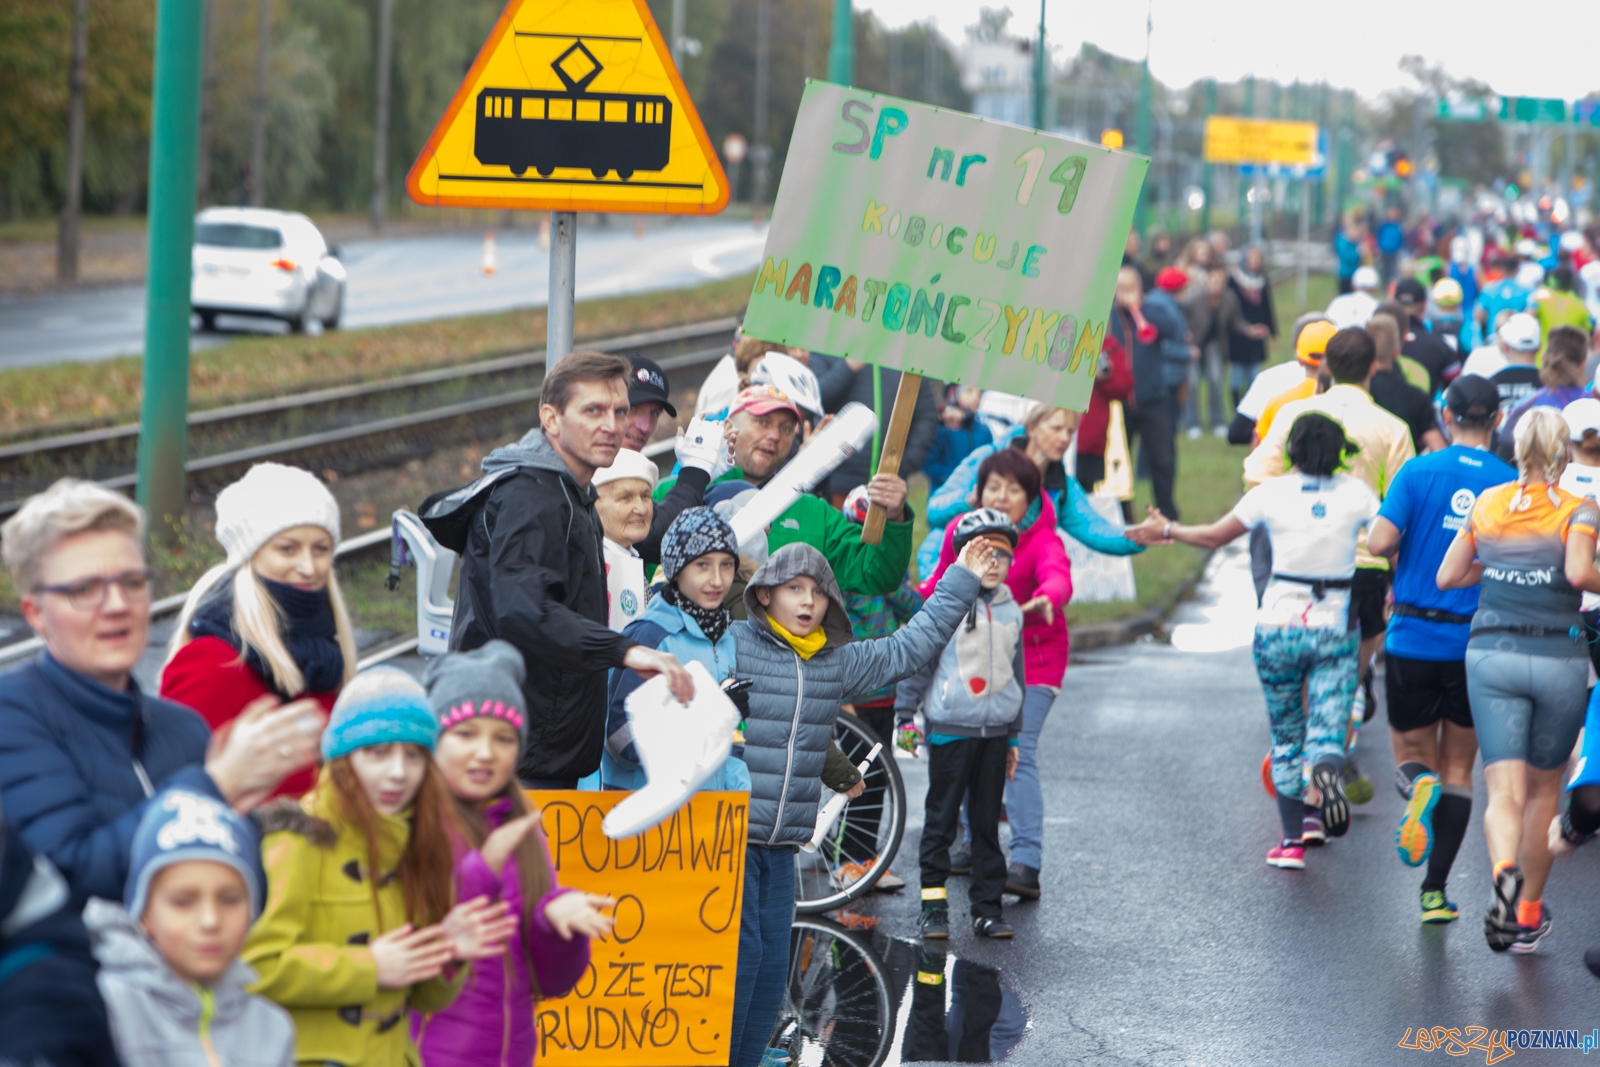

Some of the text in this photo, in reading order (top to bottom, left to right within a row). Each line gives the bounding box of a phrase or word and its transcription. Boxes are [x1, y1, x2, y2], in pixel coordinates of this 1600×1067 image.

[832, 99, 909, 161] SP
[926, 146, 986, 187] nr
[862, 200, 1047, 278] KIBICUJE
[754, 256, 1104, 377] MARATOŃCZYKOM
[603, 951, 645, 997] ŻE
[641, 962, 724, 1028] JEST
